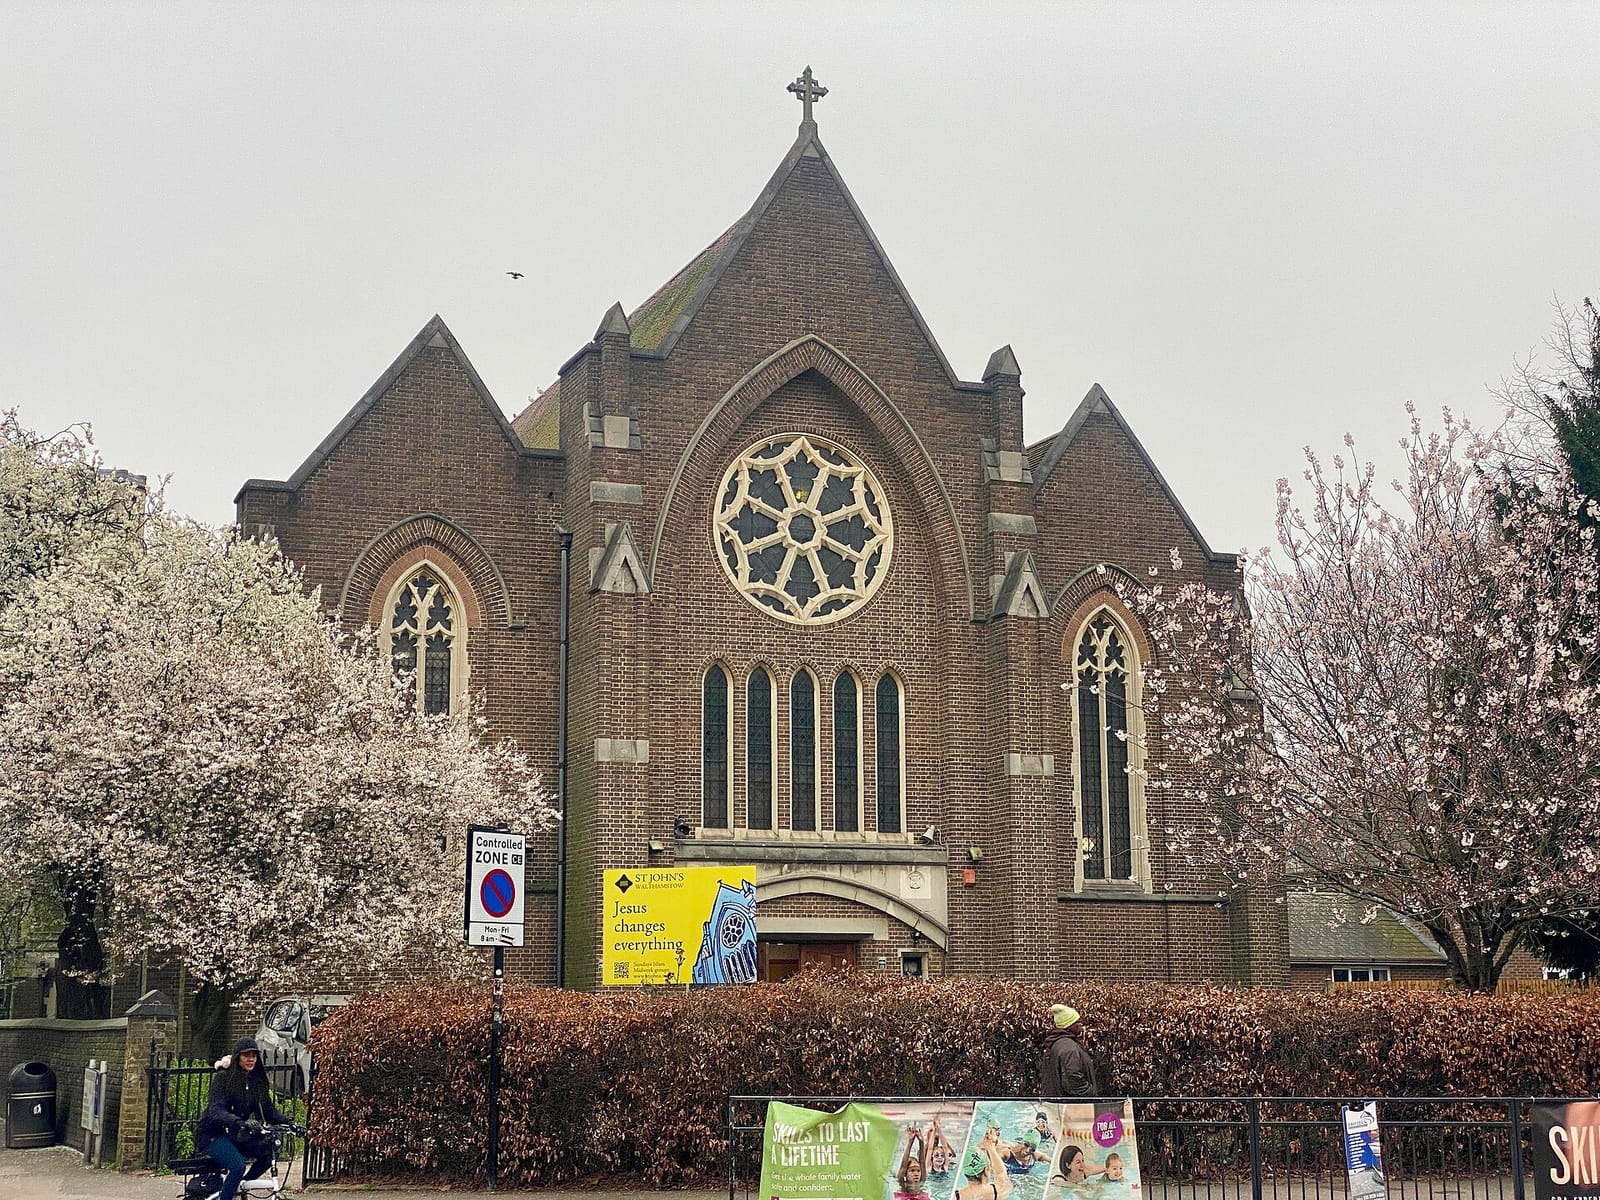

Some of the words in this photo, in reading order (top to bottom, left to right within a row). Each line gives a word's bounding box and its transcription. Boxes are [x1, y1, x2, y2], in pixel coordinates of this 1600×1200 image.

[476, 836, 523, 850] Controlled
[476, 851, 508, 864] ZONE
[635, 873, 648, 882] ST
[649, 872, 685, 883] JOHN'S
[612, 901, 647, 918] Jesus
[614, 918, 665, 936] changes
[614, 936, 683, 954] everything
[773, 1122, 812, 1144] SKILLS
[818, 1122, 834, 1143] TO
[839, 1121, 870, 1143] LAST
[1097, 1122, 1108, 1132] FOR
[1108, 1120, 1116, 1130] ALL
[771, 1144, 777, 1165] A
[782, 1145, 840, 1166] LIFETIME
[817, 1172, 840, 1182] family
[783, 1183, 798, 1191] and
